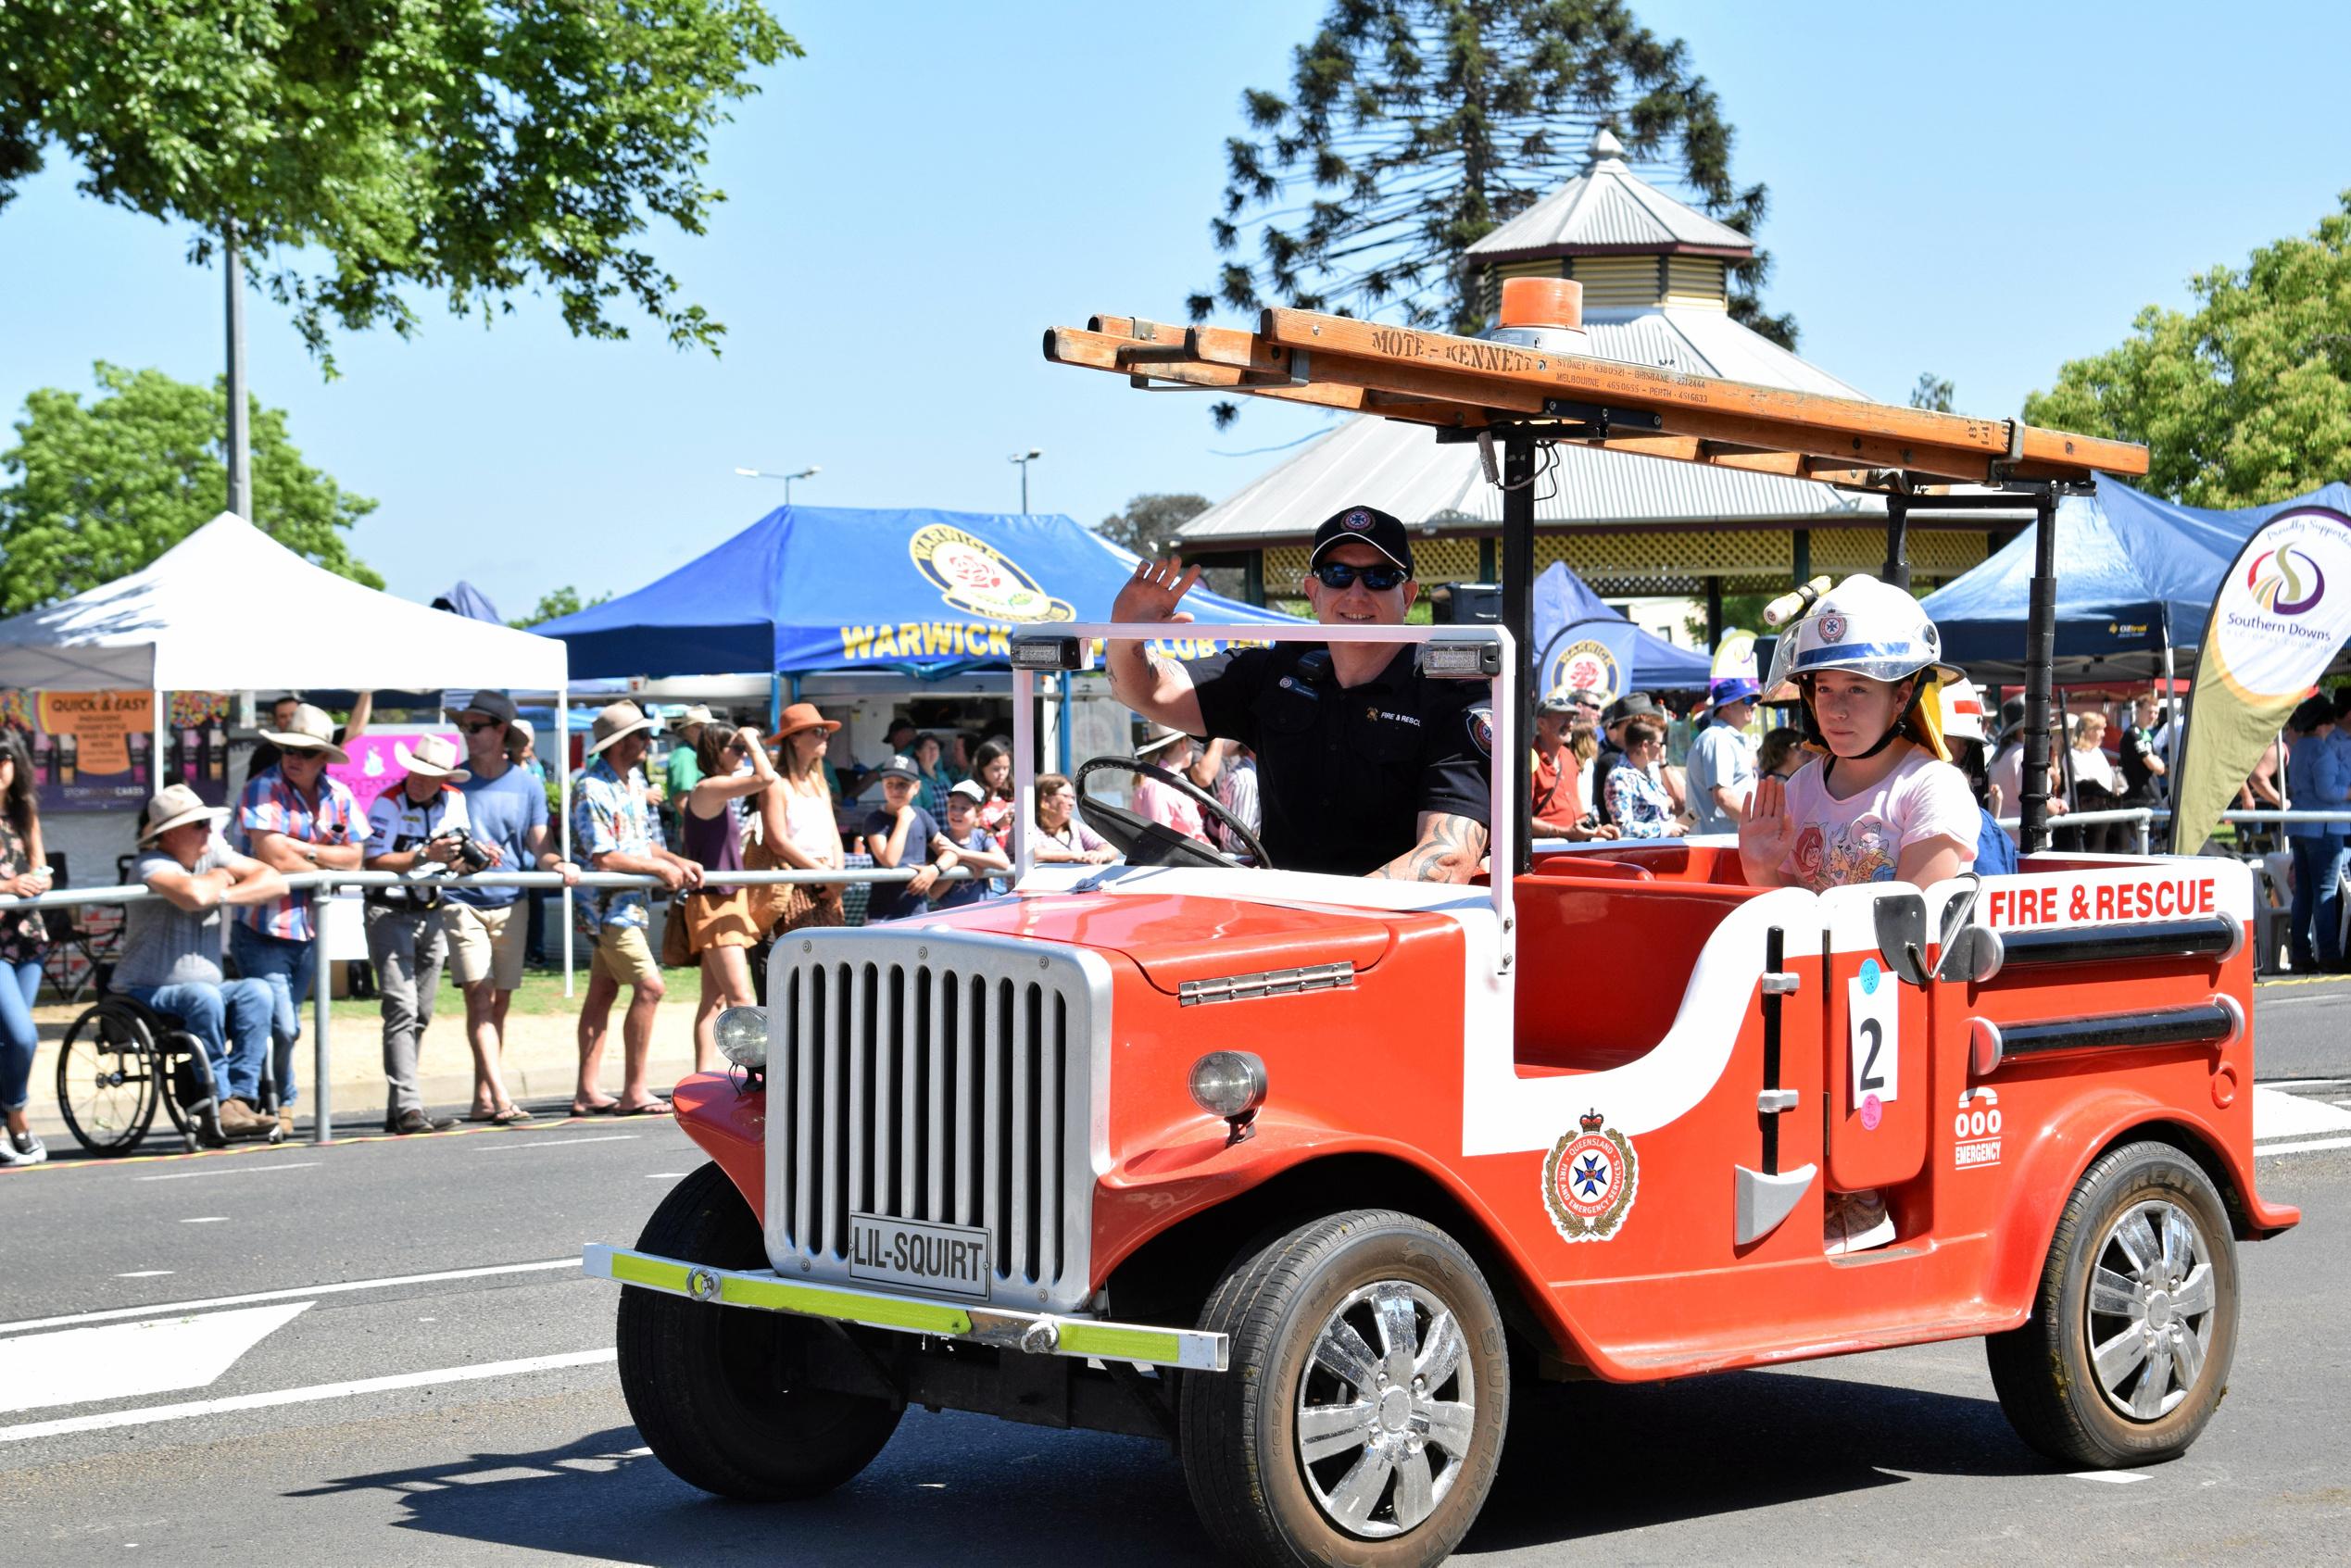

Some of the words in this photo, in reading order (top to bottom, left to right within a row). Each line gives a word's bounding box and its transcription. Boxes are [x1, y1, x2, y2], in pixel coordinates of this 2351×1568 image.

[1372, 330, 1425, 358] MOTE
[1445, 344, 1532, 372] KENNETT
[1557, 358, 1587, 370] SYDNEY
[1634, 370, 1669, 383] BRISBANE
[1556, 372, 1600, 388] MELBOURNE
[1649, 388, 1672, 398] PERTH
[2267, 519, 2306, 541] Proudly
[913, 526, 999, 561] WARWICK
[840, 621, 1012, 659] WARWICK
[2227, 612, 2285, 633] Southern
[2289, 622, 2332, 642] Downs
[52, 699, 95, 712] QUICK
[100, 698, 112, 711] &
[114, 697, 148, 711] EASY
[1380, 711, 1395, 721] FIRE
[1990, 886, 2058, 927] FIRE
[2068, 884, 2091, 922] &
[2096, 878, 2215, 921] RESCUE
[1859, 1017, 1885, 1092] 2
[1955, 1109, 2002, 1138] 000
[1569, 1137, 1614, 1156] QUEENSLAND
[1955, 1141, 2002, 1165] EMERGENCY
[1559, 1162, 1567, 1182] FIRE
[1608, 1160, 1622, 1200] SERVICES
[1560, 1183, 1571, 1201] AND
[1568, 1199, 1610, 1214] EMERGENCY
[854, 1226, 984, 1282] LIL-SQUIRT
